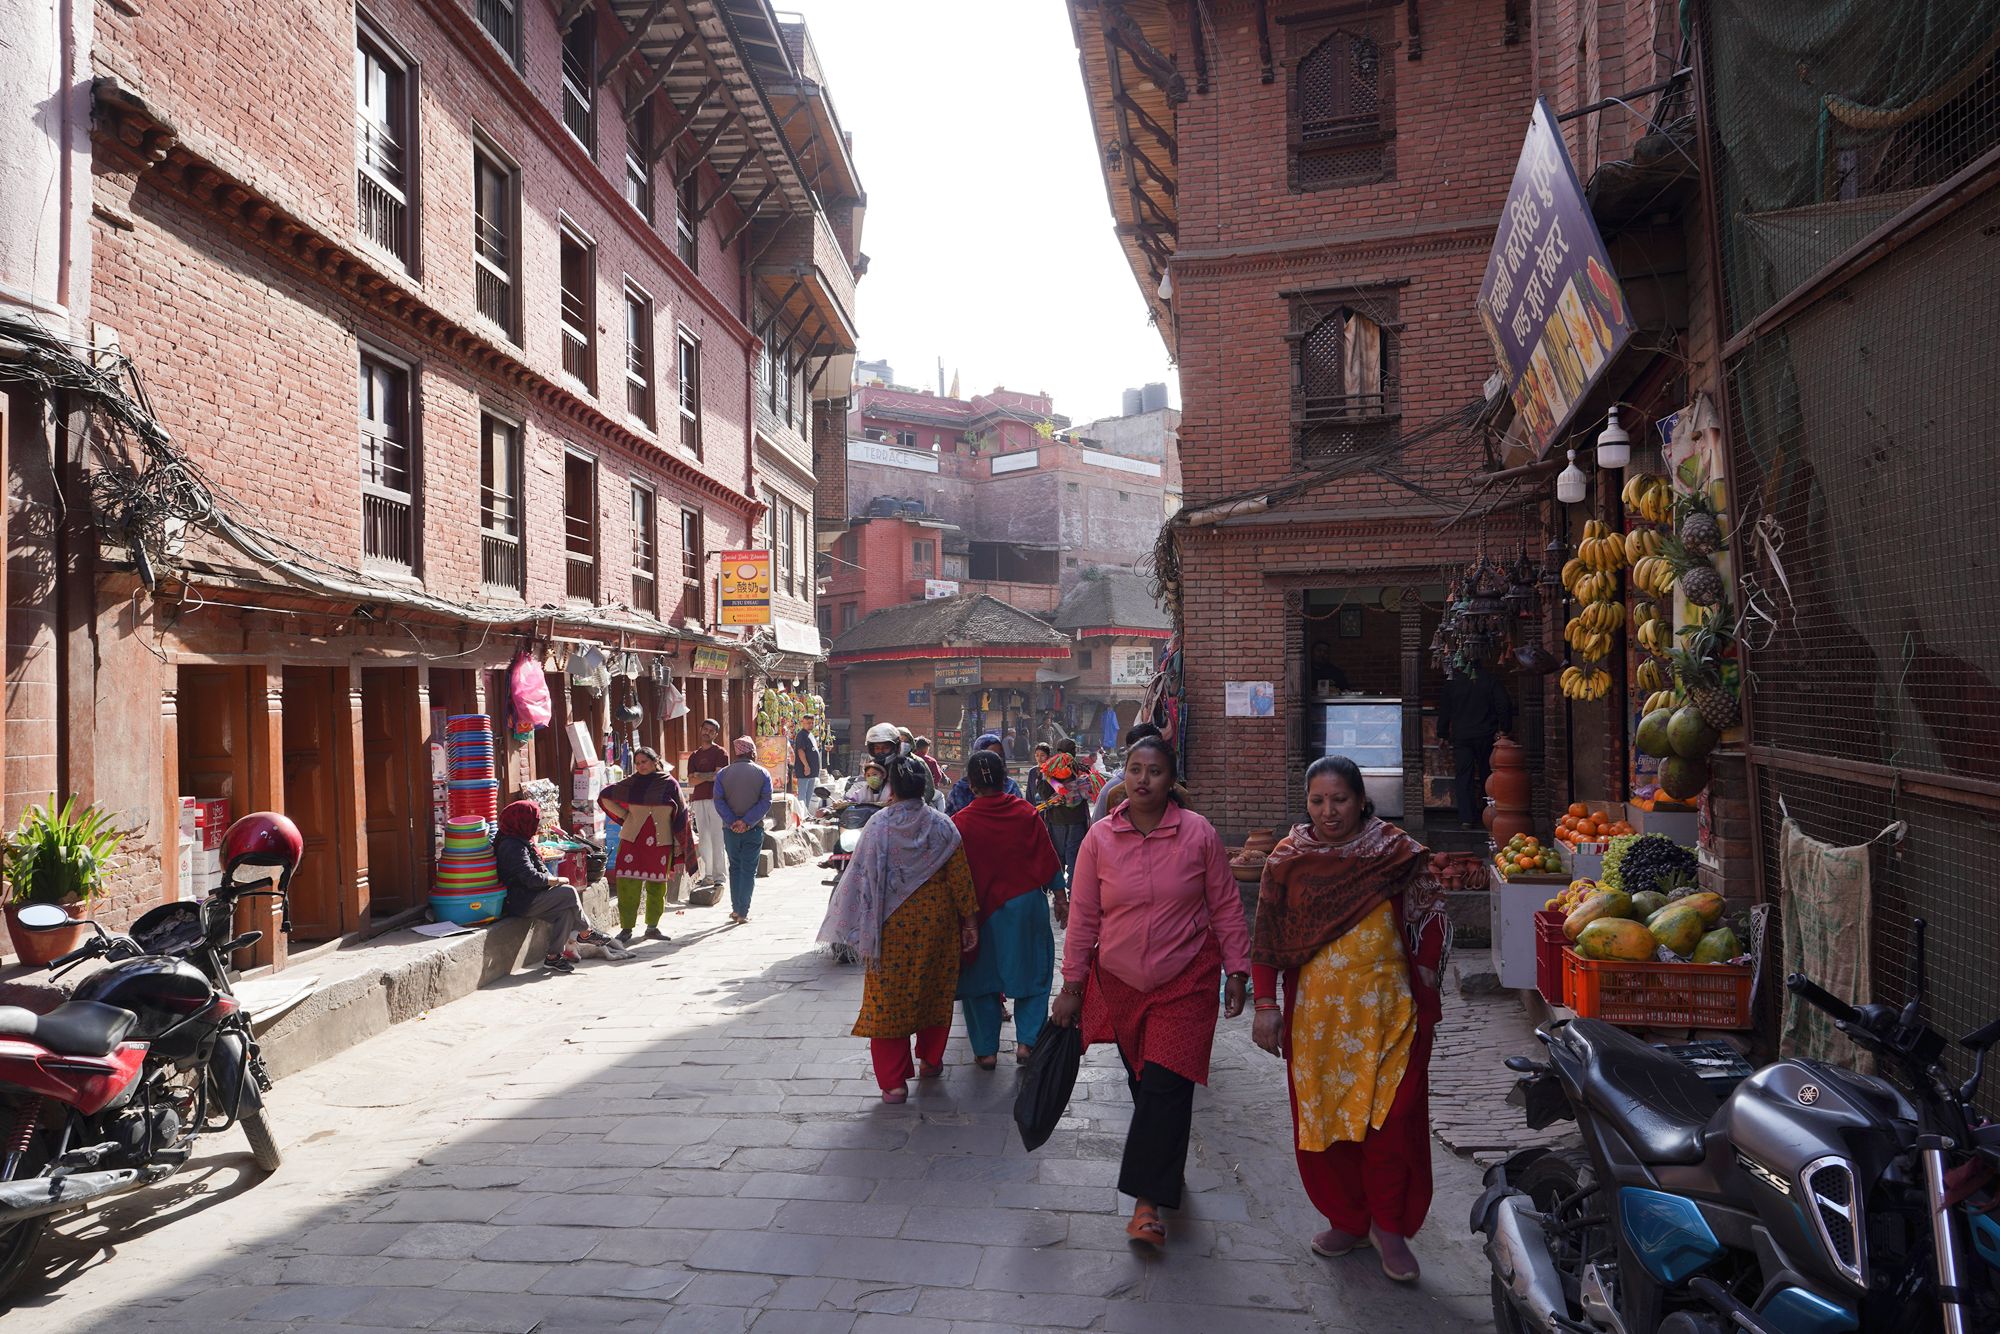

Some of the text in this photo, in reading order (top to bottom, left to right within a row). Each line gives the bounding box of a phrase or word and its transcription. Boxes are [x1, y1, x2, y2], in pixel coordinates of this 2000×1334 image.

[1489, 254, 1514, 323] लक्ष्मी
[1505, 184, 1540, 274] नरसिंह
[1511, 213, 1570, 348] एण्ड जुस सेन्टर
[863, 446, 910, 465] TERRACE
[736, 581, 759, 593] 酸奶
[935, 667, 978, 677] POTTERY SQUARE
[1736, 1152, 1791, 1195] FZS
